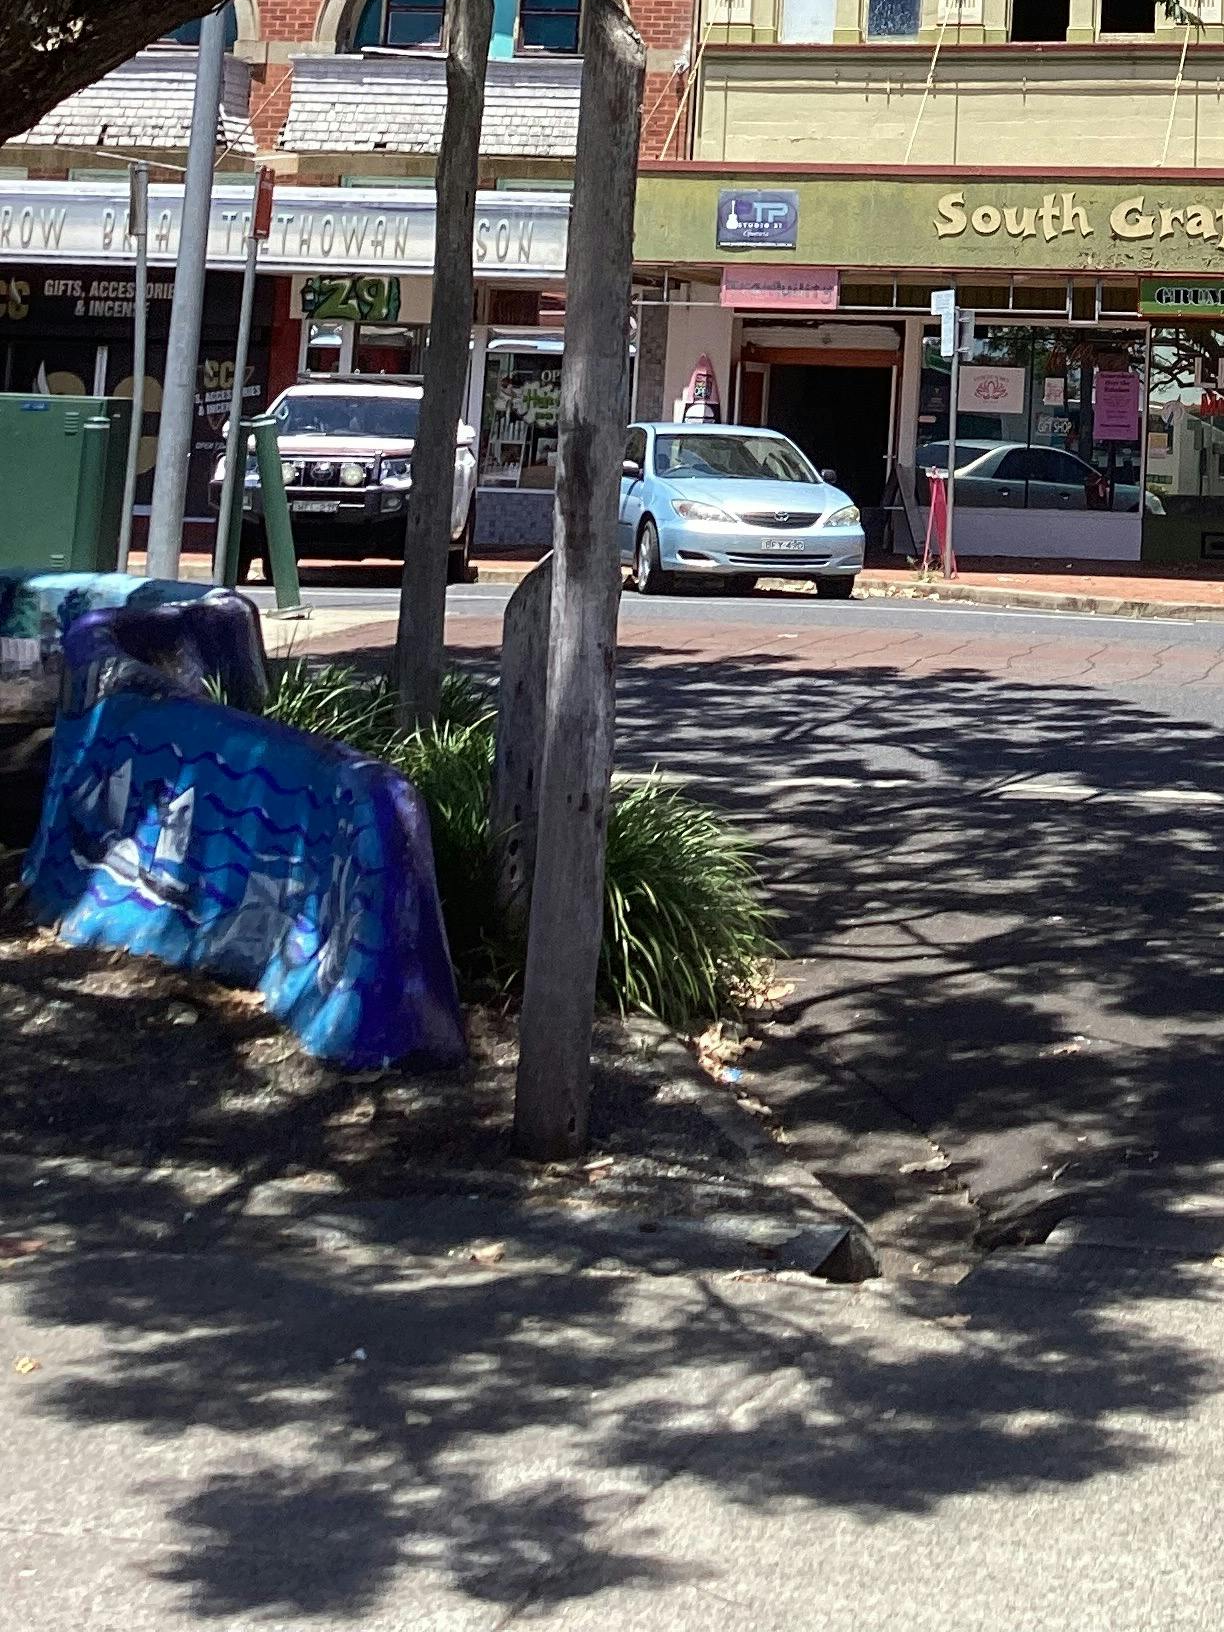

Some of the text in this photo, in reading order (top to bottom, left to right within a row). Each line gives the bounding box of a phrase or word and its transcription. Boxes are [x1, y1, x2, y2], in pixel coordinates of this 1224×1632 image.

[932, 191, 1094, 241] South
[476, 218, 534, 265] SON
[43, 279, 175, 300] GIFTS, ACCESORIE
[74, 300, 86, 317] &
